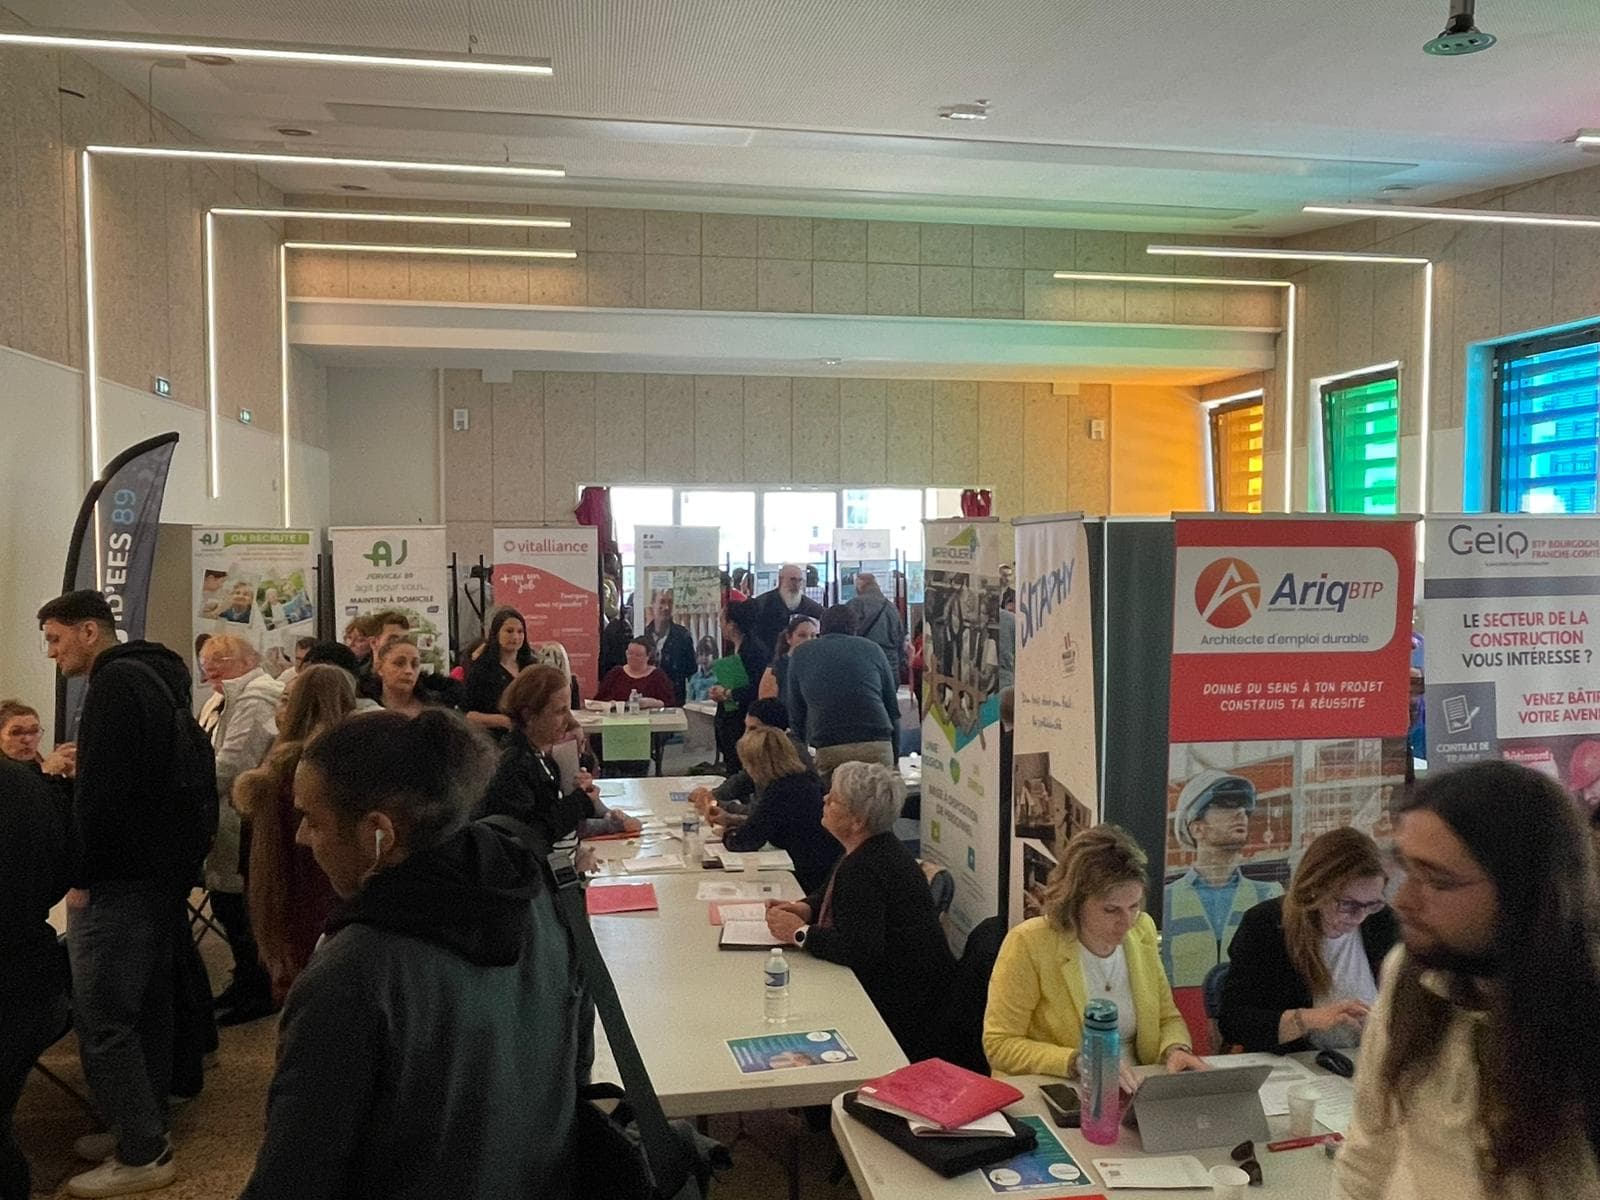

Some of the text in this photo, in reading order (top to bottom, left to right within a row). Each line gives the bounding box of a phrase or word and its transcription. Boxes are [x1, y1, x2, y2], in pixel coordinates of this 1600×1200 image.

[112, 489, 136, 525] 89
[231, 534, 247, 543] ON
[249, 533, 297, 543] RECRUTE
[518, 537, 589, 553] vitalliance
[1531, 540, 1547, 549] BTP
[363, 539, 407, 568] AJ
[518, 579, 536, 594] job
[1268, 572, 1384, 613] Ariq BTP
[396, 595, 434, 603] DOMICILE
[1019, 557, 1075, 649] SITAPHY
[1463, 610, 1589, 628] LE SECTEUR DE LA
[1201, 632, 1369, 648] Architecte d'emploi durable
[1470, 630, 1584, 648] CONSTRUCTION
[1462, 647, 1593, 668] VOUS INTÉRESSE ?
[1203, 679, 1384, 695] DONNE DU SENS À TON PROJET
[1220, 695, 1366, 712] CONSTRUIS TA RÉUSSITE
[1523, 692, 1565, 707] VENEZ
[1518, 709, 1560, 724] VOTRE
[1436, 741, 1490, 753] CONTRAT DE
